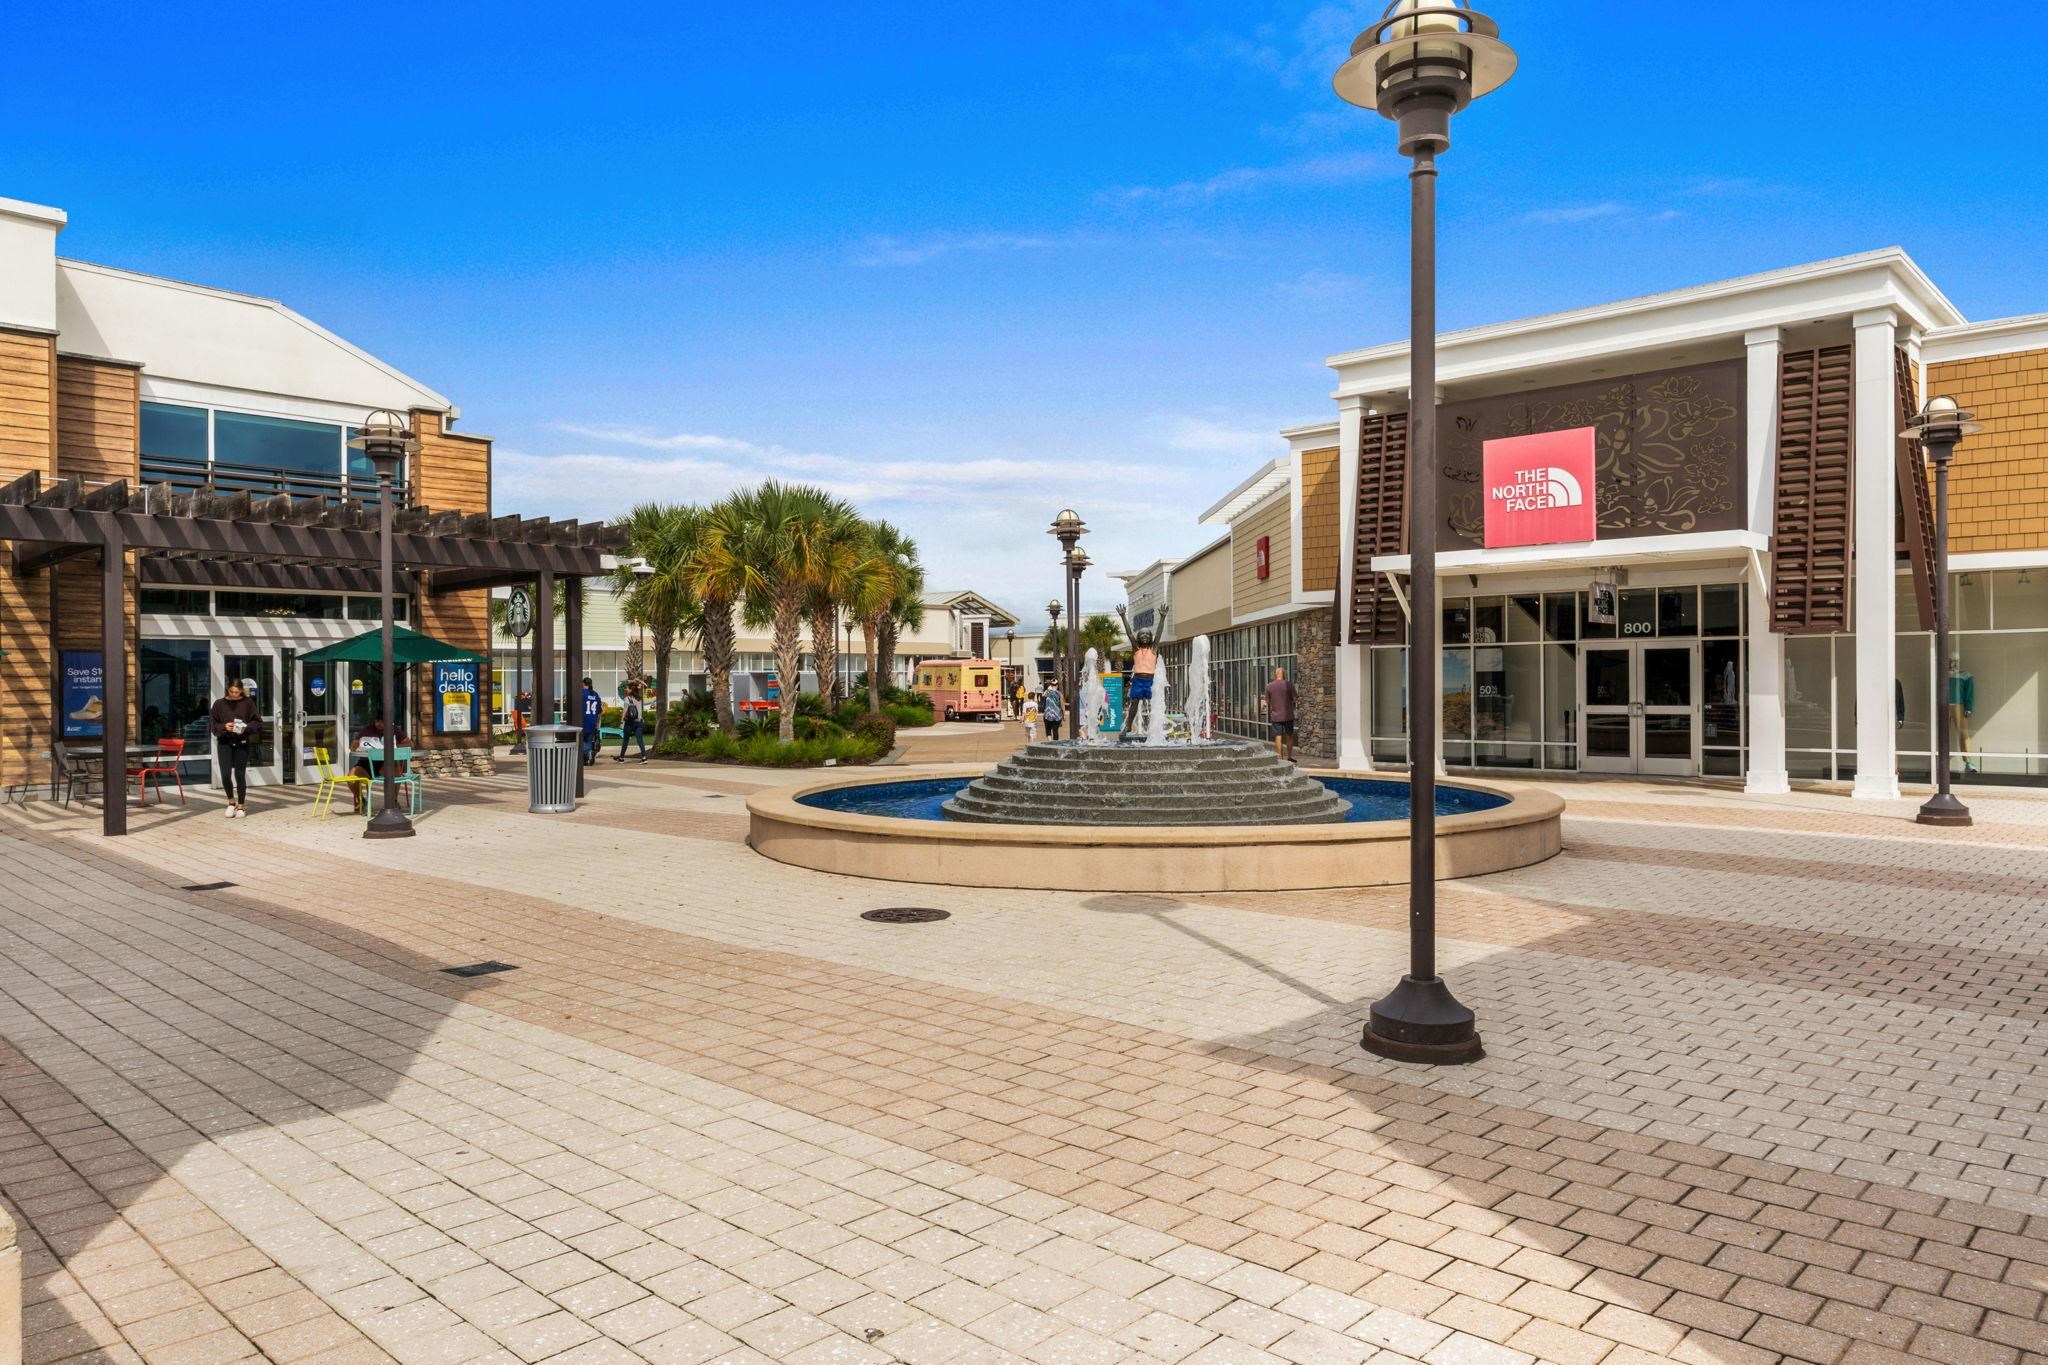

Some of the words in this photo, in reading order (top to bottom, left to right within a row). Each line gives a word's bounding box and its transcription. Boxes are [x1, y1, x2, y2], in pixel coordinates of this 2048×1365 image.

[1515, 468, 1546, 483] THE
[1492, 481, 1547, 500] NORTH
[1506, 495, 1547, 512] FACE
[1624, 622, 1651, 634] 800
[67, 667, 90, 676] Save
[91, 667, 102, 676] $1
[440, 668, 474, 681] hello
[438, 681, 475, 693] deals
[585, 700, 597, 714] 14
